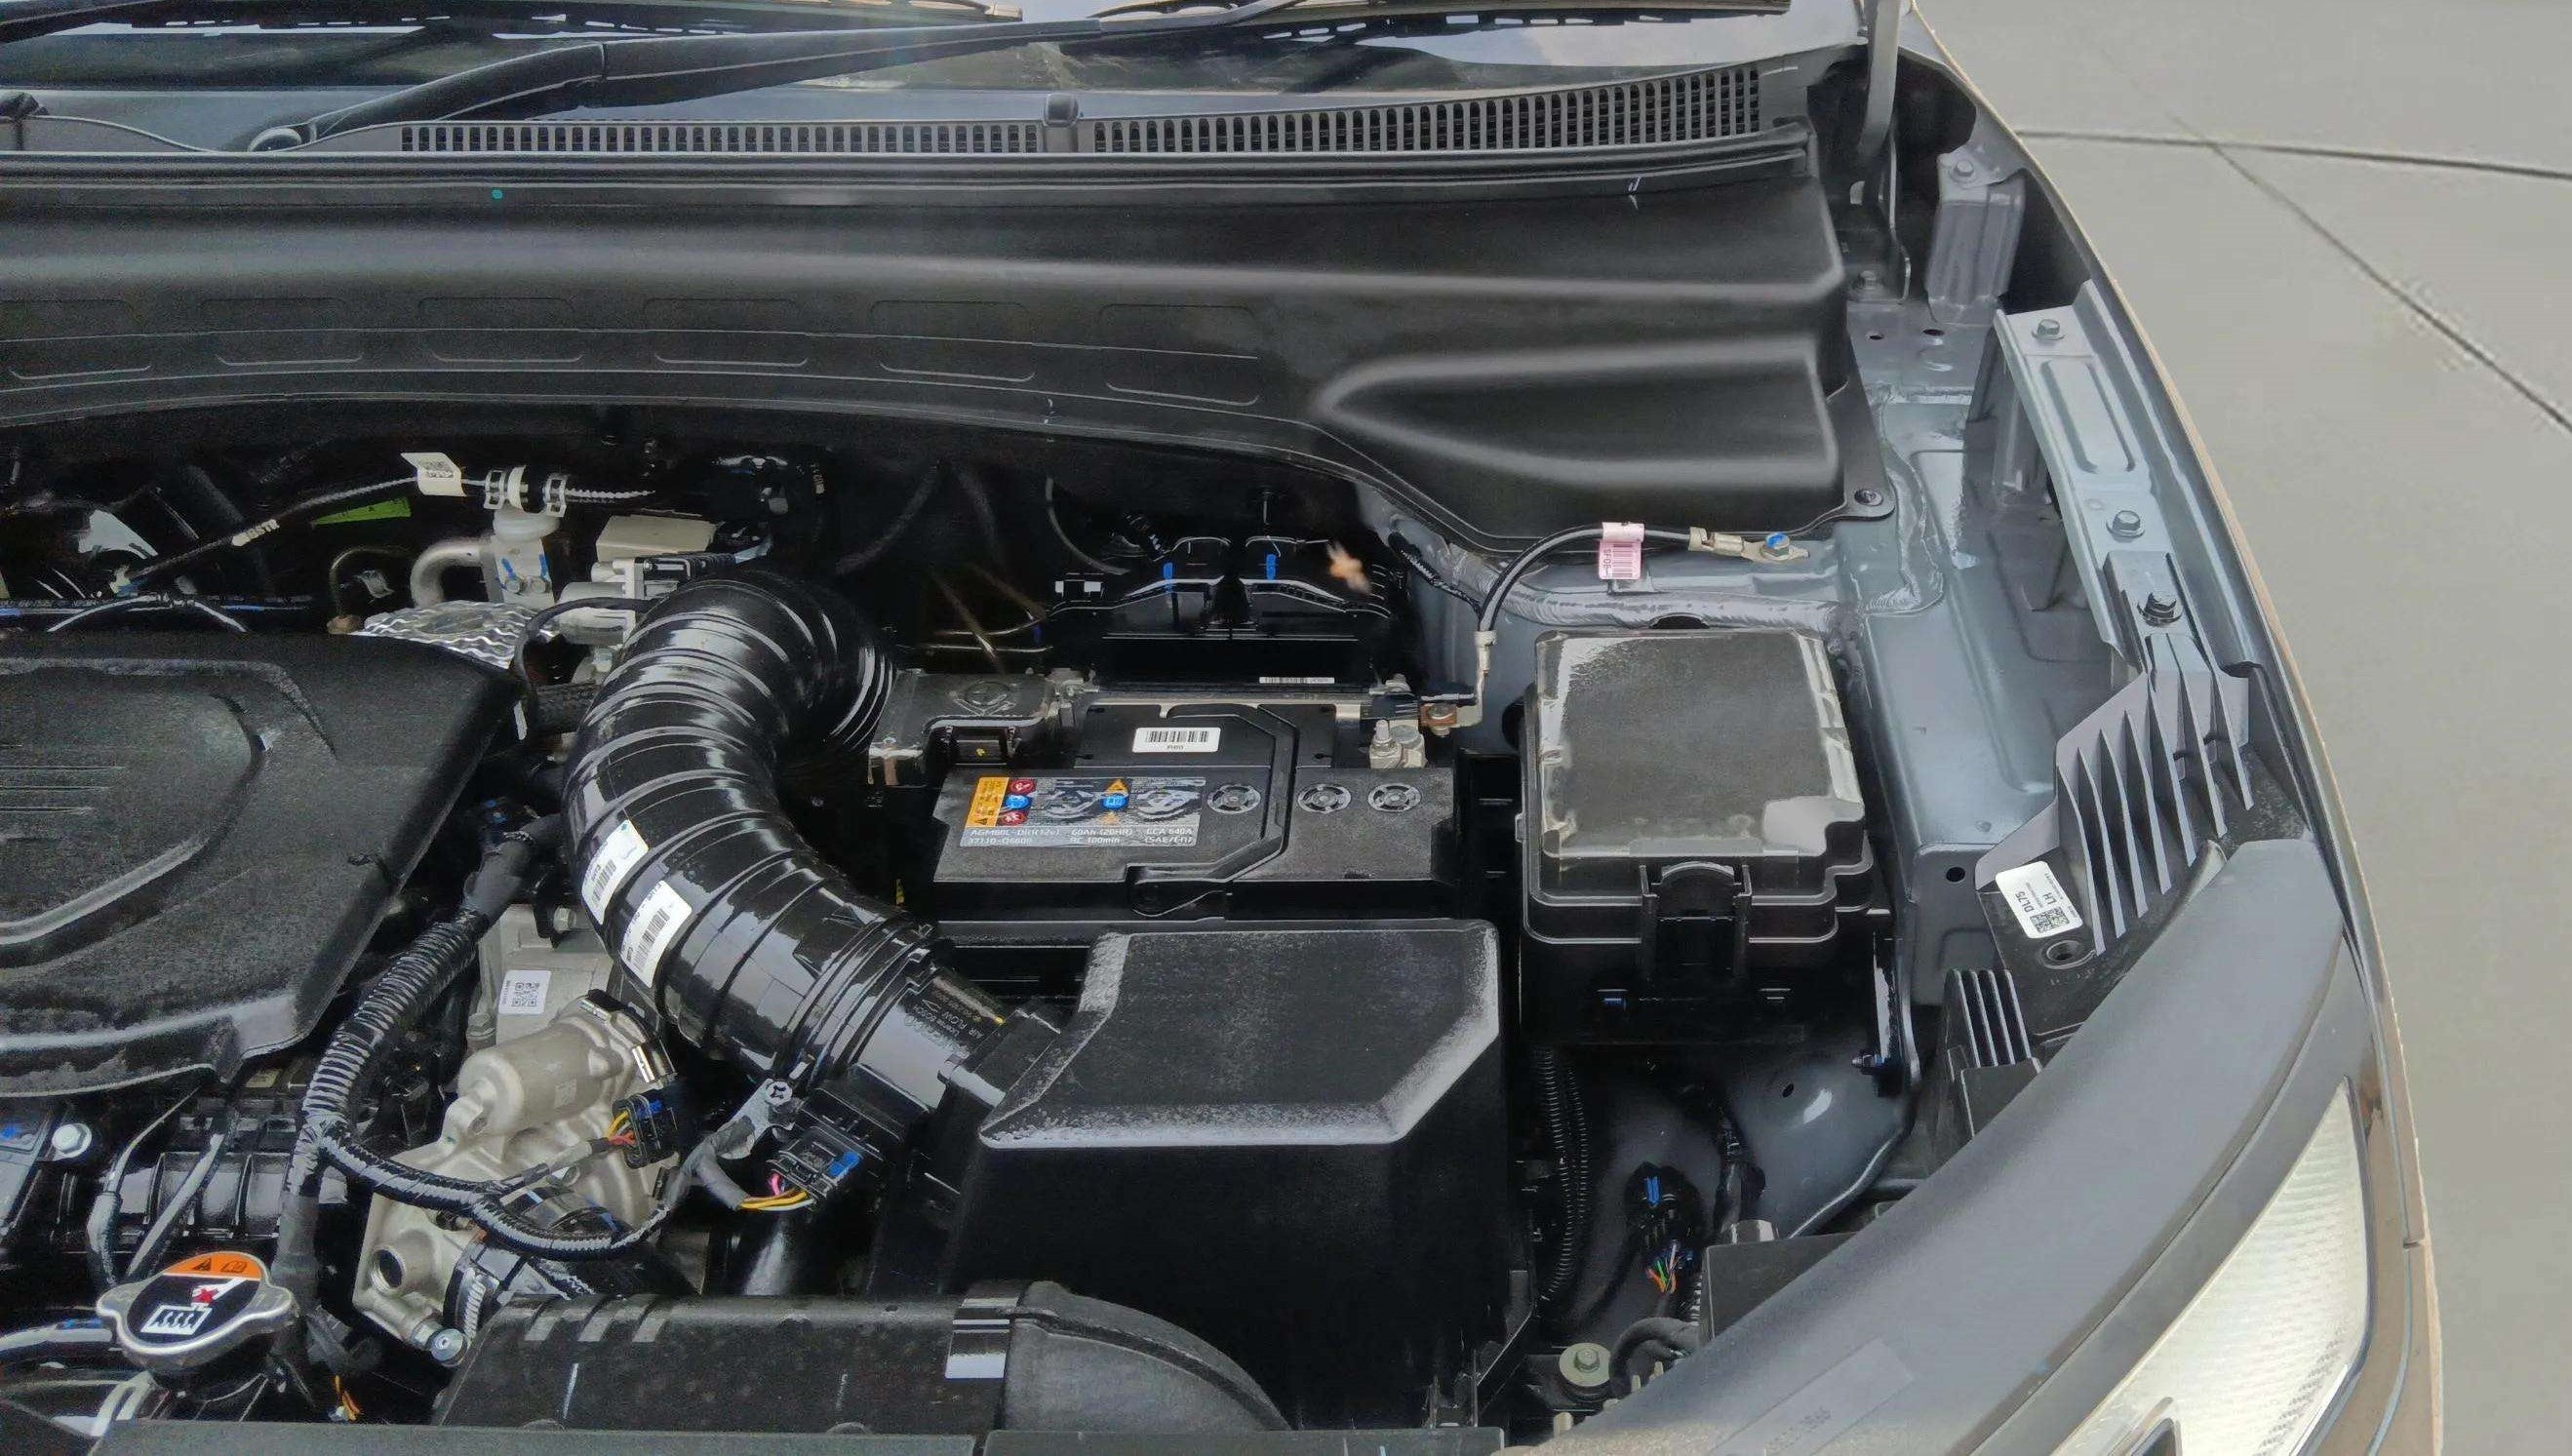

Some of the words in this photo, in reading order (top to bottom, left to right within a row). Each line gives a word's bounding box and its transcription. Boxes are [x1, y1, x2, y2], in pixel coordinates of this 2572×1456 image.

[2015, 891, 2035, 913] DL75
[2042, 892, 2056, 905] LH
[941, 1011, 968, 1030] FLOW
[968, 1027, 985, 1040] AIR
